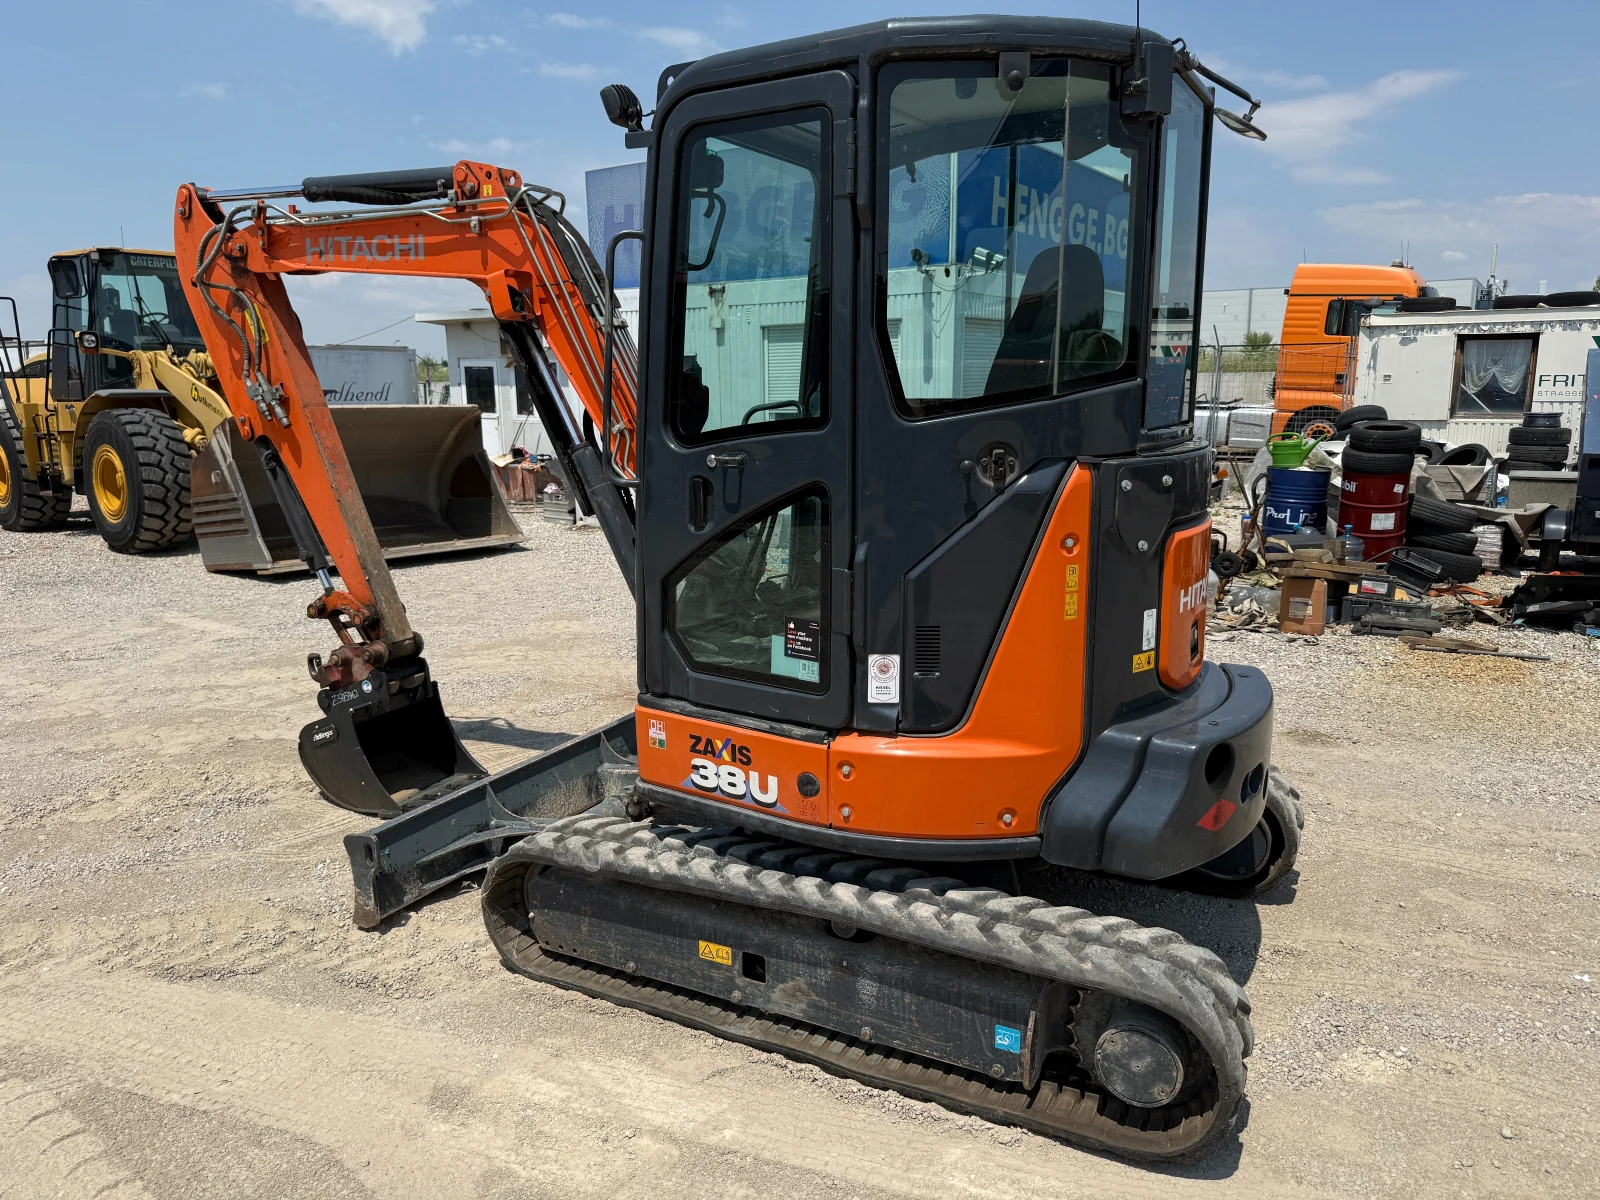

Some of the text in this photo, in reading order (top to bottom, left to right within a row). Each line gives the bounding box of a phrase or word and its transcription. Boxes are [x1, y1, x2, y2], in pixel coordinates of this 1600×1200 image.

[991, 174, 1130, 260] HENGGE.BG
[305, 234, 425, 263] HITACHI
[130, 255, 178, 269] CATERPIL
[325, 381, 394, 402] ndhendl
[1538, 374, 1587, 387] FRIT
[1341, 479, 1356, 493] obil
[1266, 507, 1317, 526] ProLine
[1180, 577, 1208, 614] HITA
[689, 734, 752, 766] ZAXIS
[690, 758, 778, 809] 38U
